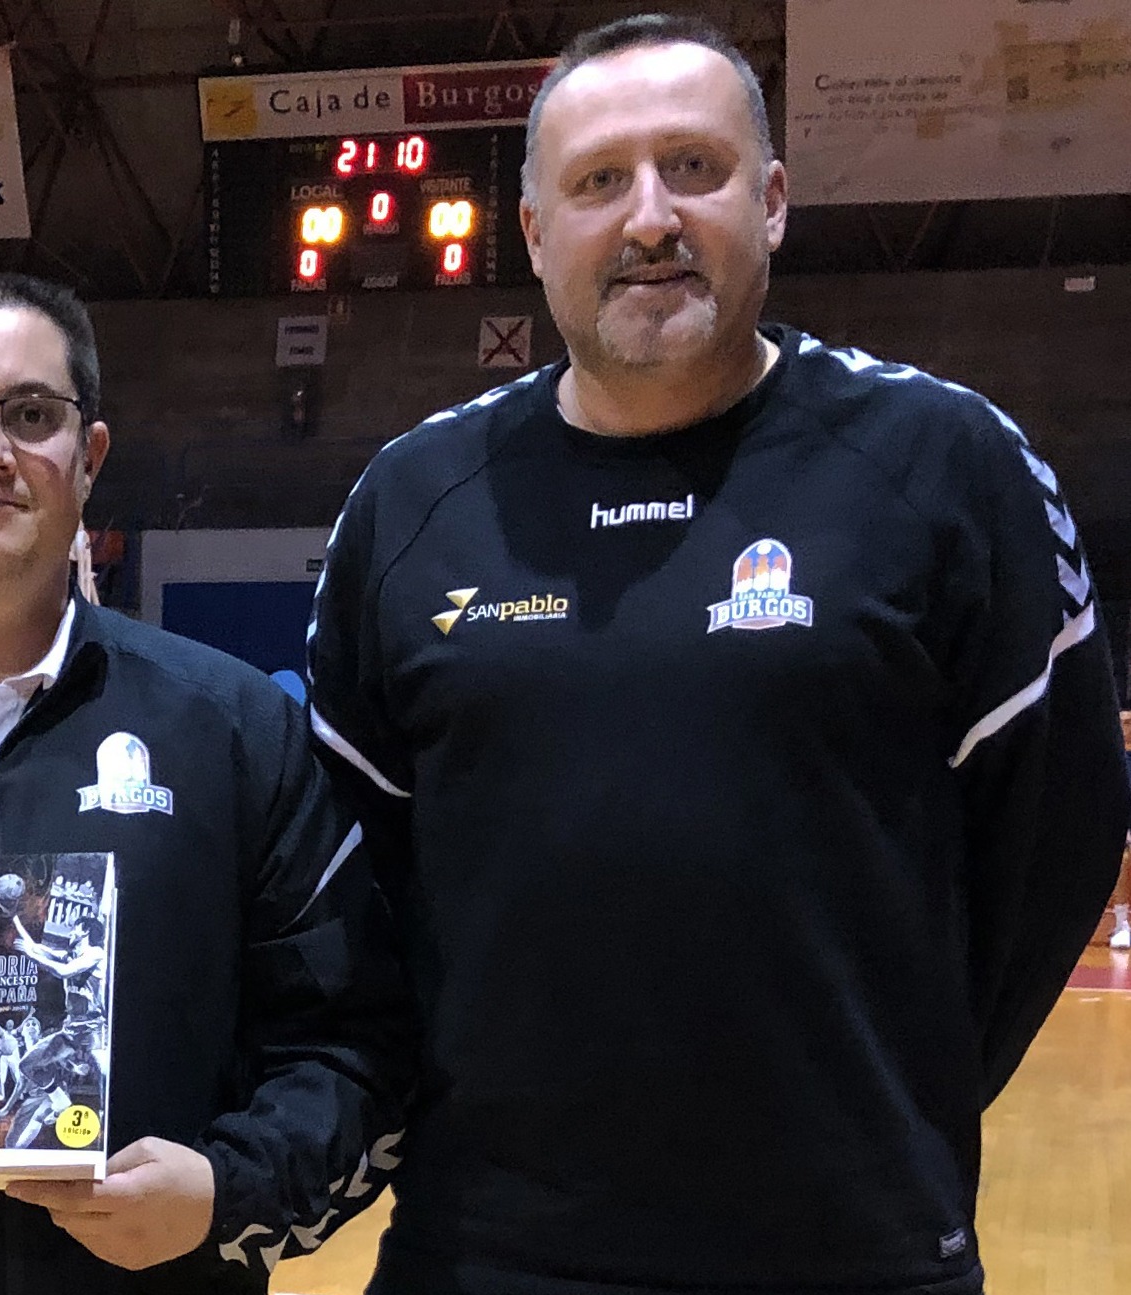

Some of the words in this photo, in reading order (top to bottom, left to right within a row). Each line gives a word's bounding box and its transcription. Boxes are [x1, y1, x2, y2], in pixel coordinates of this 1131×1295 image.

[270, 89, 341, 118] Caja
[354, 84, 391, 109] de
[590, 493, 694, 529] hummel
[716, 598, 807, 625] BURGOS
[84, 786, 169, 809] BRGOS
